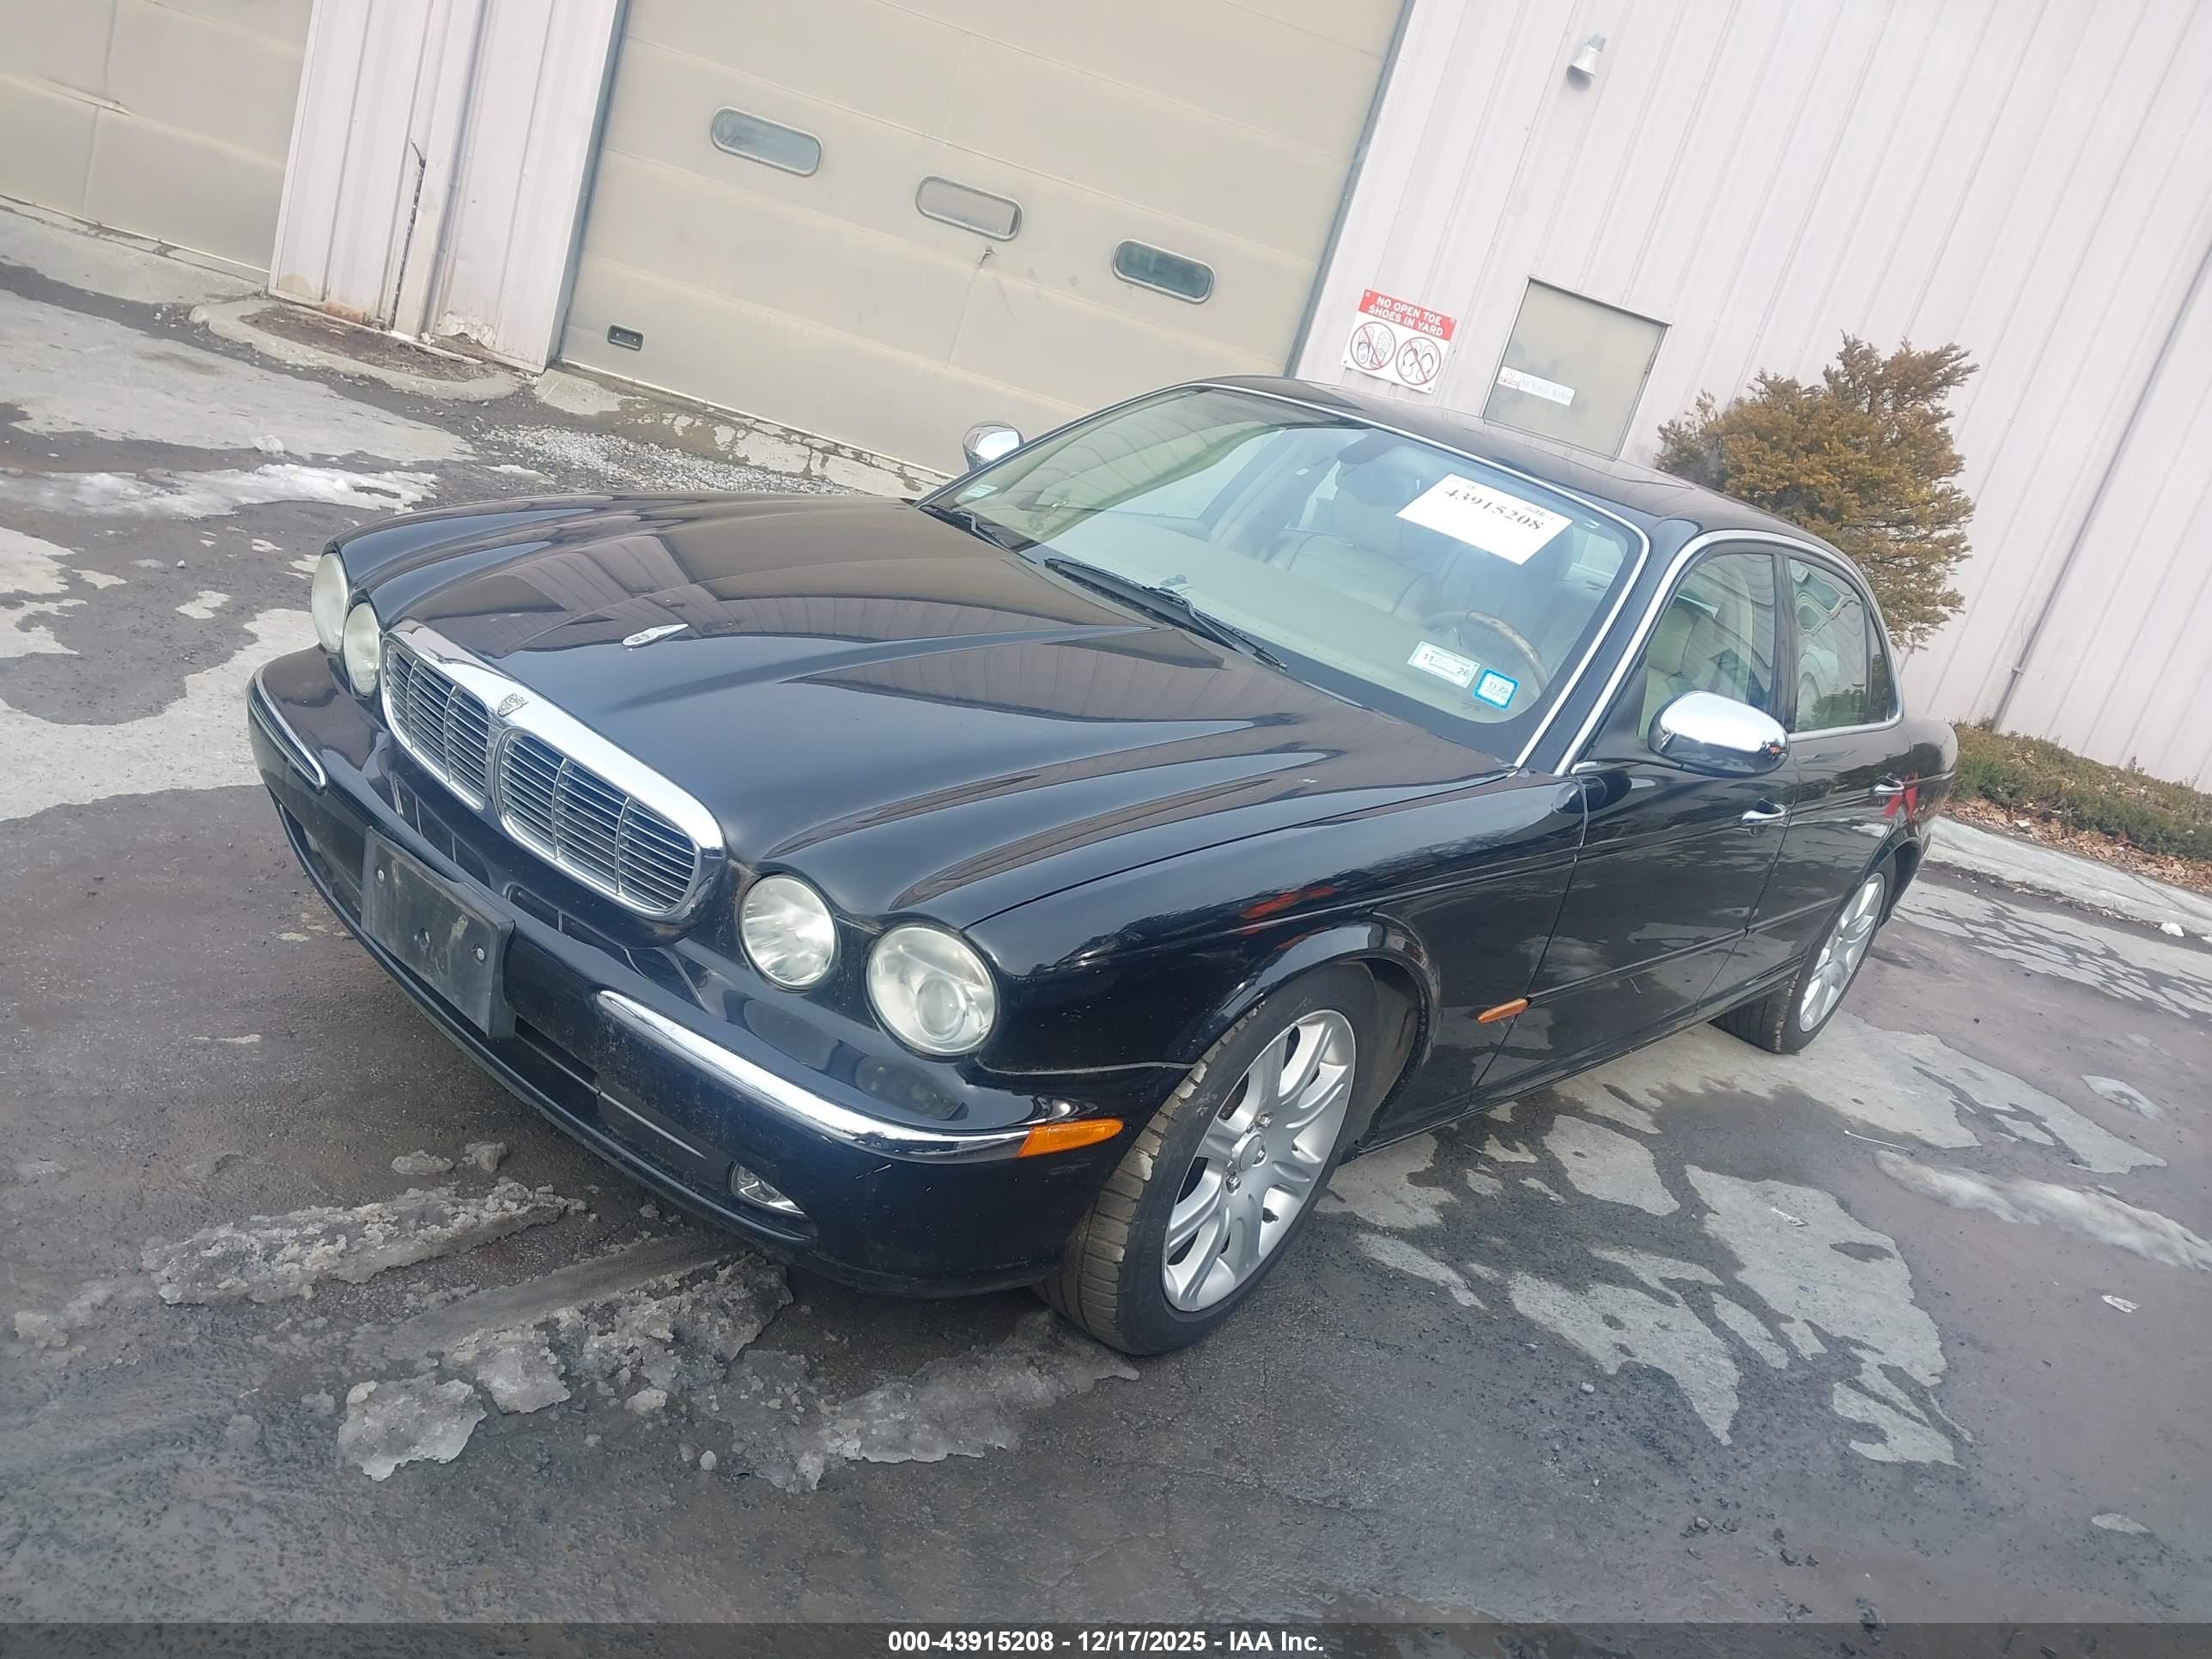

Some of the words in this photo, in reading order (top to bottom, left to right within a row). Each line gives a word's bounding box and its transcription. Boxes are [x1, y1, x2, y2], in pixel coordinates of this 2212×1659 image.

[1368, 304, 1402, 323] SHOES
[1403, 314, 1416, 327] IN
[1418, 319, 1443, 337] YARD
[1376, 295, 1392, 308] NO
[1394, 300, 1421, 318] OPEN
[1423, 310, 1443, 325] TOE
[1444, 488, 1544, 530] 43915208
